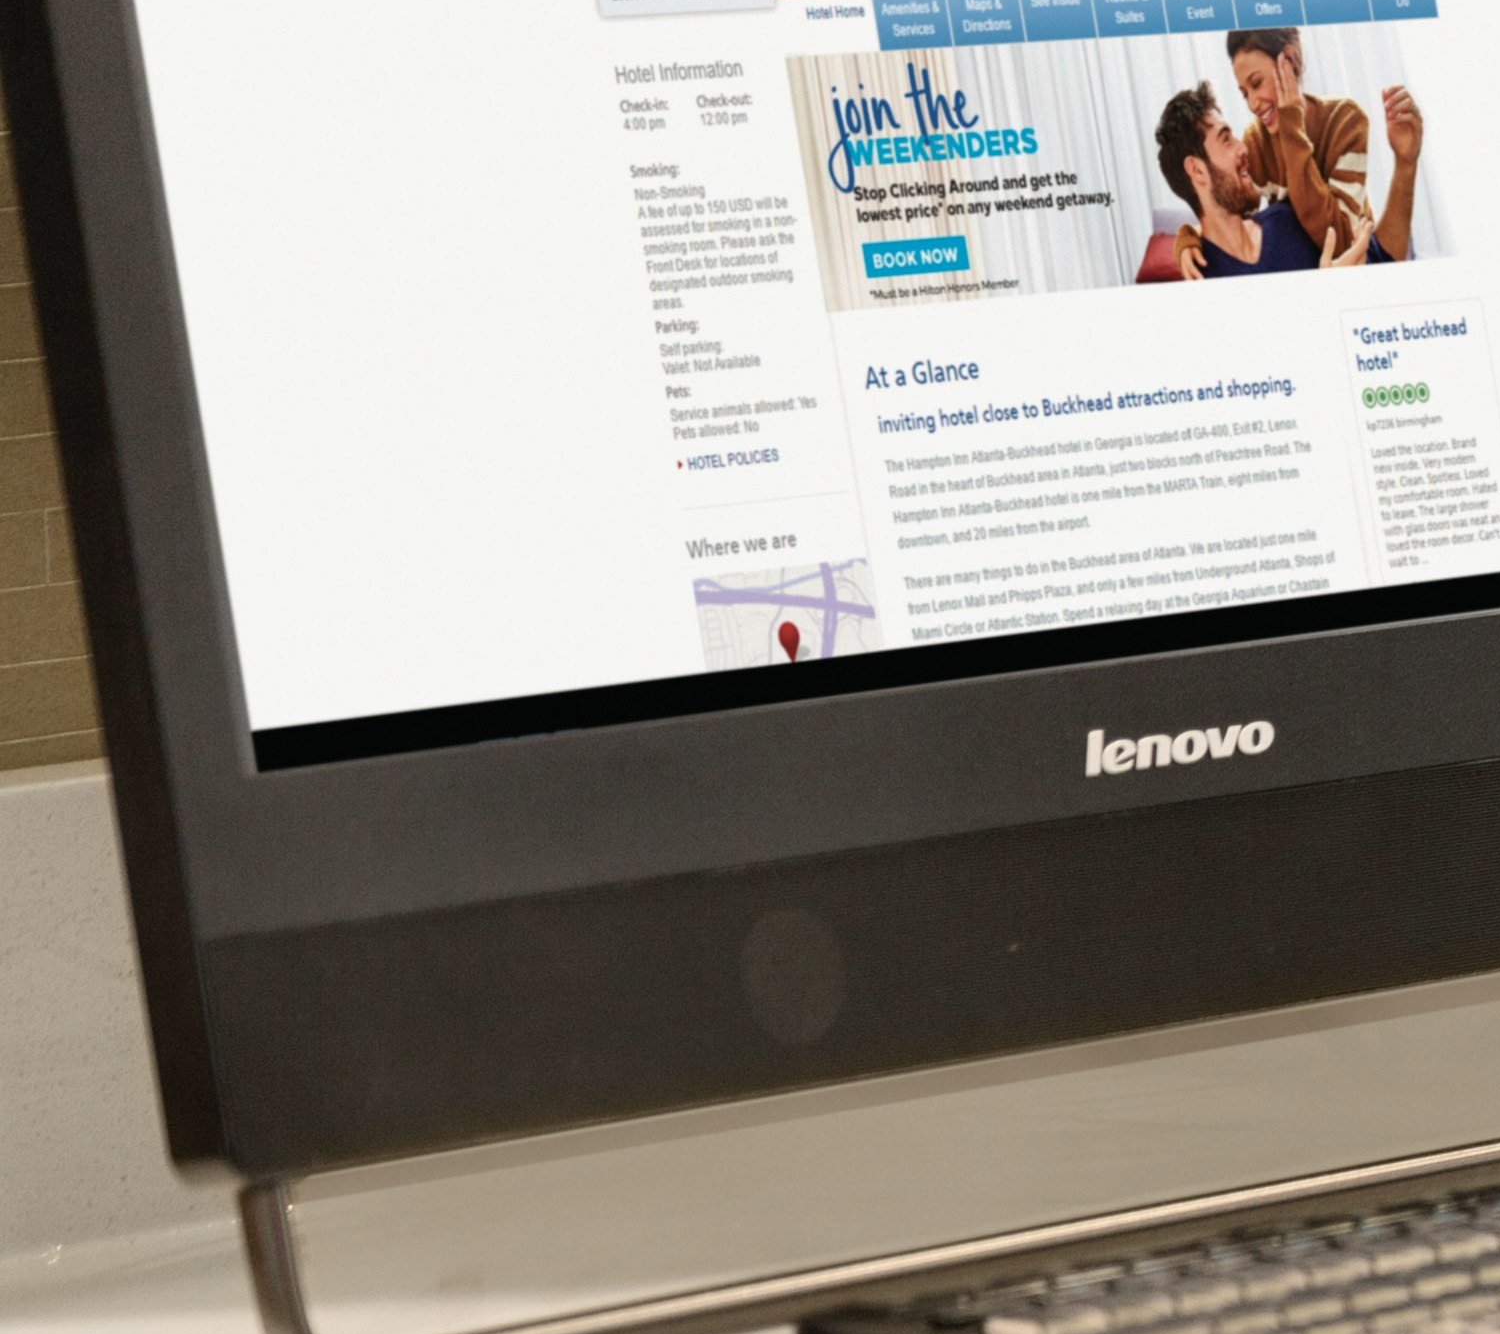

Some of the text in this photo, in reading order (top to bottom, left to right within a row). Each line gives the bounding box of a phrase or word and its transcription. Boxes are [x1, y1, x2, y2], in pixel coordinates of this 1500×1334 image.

[805, 5, 865, 20] Hotel Home
[881, 0, 940, 15] Amenities &
[1186, 6, 1214, 19] Event
[1254, 2, 1282, 15] Offers
[962, 18, 1012, 33] Directions
[1114, 10, 1145, 24] Suites
[892, 23, 935, 37] Services
[613, 59, 744, 85] Hotel Information
[618, 97, 669, 114] Check-in:
[695, 93, 753, 109] Check-out:
[622, 115, 666, 132] 4:00 pm
[699, 110, 748, 127] 12:00 pm
[828, 63, 979, 193] join the
[851, 127, 1038, 167] WEEKENDERS
[628, 162, 680, 179] Smoking:
[633, 184, 706, 201] Non-Smoking
[852, 170, 1078, 205] Stop Clicking Around and get the
[855, 206, 903, 223] lowest
[944, 202, 966, 216] on
[966, 201, 992, 217] any
[993, 192, 1054, 212] weekend
[1055, 191, 1115, 211] getaway.
[872, 247, 958, 269] BOOK NOW
[654, 318, 700, 335] Parking:
[1352, 316, 1467, 345] "Great buckhead
[1355, 350, 1398, 372] hotel"
[865, 359, 979, 390] At a Glance
[664, 385, 692, 399] Pets:
[877, 376, 1296, 434] inviting hotel close to Buckhead attractions and shopping.
[686, 447, 780, 470] HOTEL POLICIES
[684, 533, 797, 559] Where we are
[1085, 720, 1275, 778] lenovo
